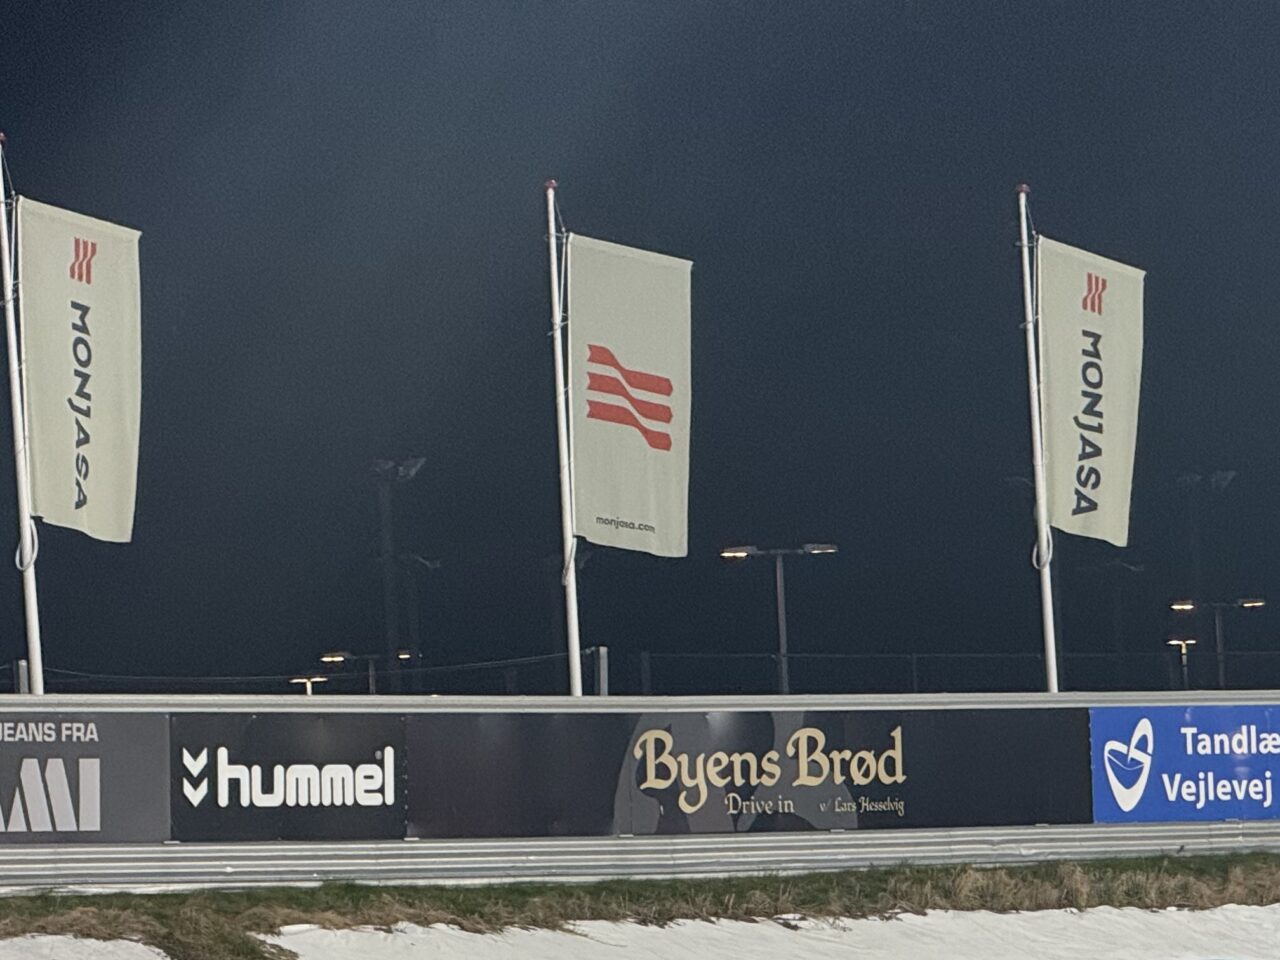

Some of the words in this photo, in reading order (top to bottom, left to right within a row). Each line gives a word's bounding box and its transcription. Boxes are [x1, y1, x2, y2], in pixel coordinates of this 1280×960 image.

[67, 300, 93, 511] MONJASA
[1072, 329, 1104, 517] MONJASA
[596, 516, 656, 533] monjasa.com
[61, 722, 99, 742] FRA
[217, 746, 394, 808] hummel
[633, 729, 783, 814] Byens
[786, 725, 907, 787] Brød
[725, 792, 774, 814] Drive
[778, 795, 795, 813] in
[834, 797, 857, 812] Lars
[1161, 771, 1274, 813] Vejlevej
